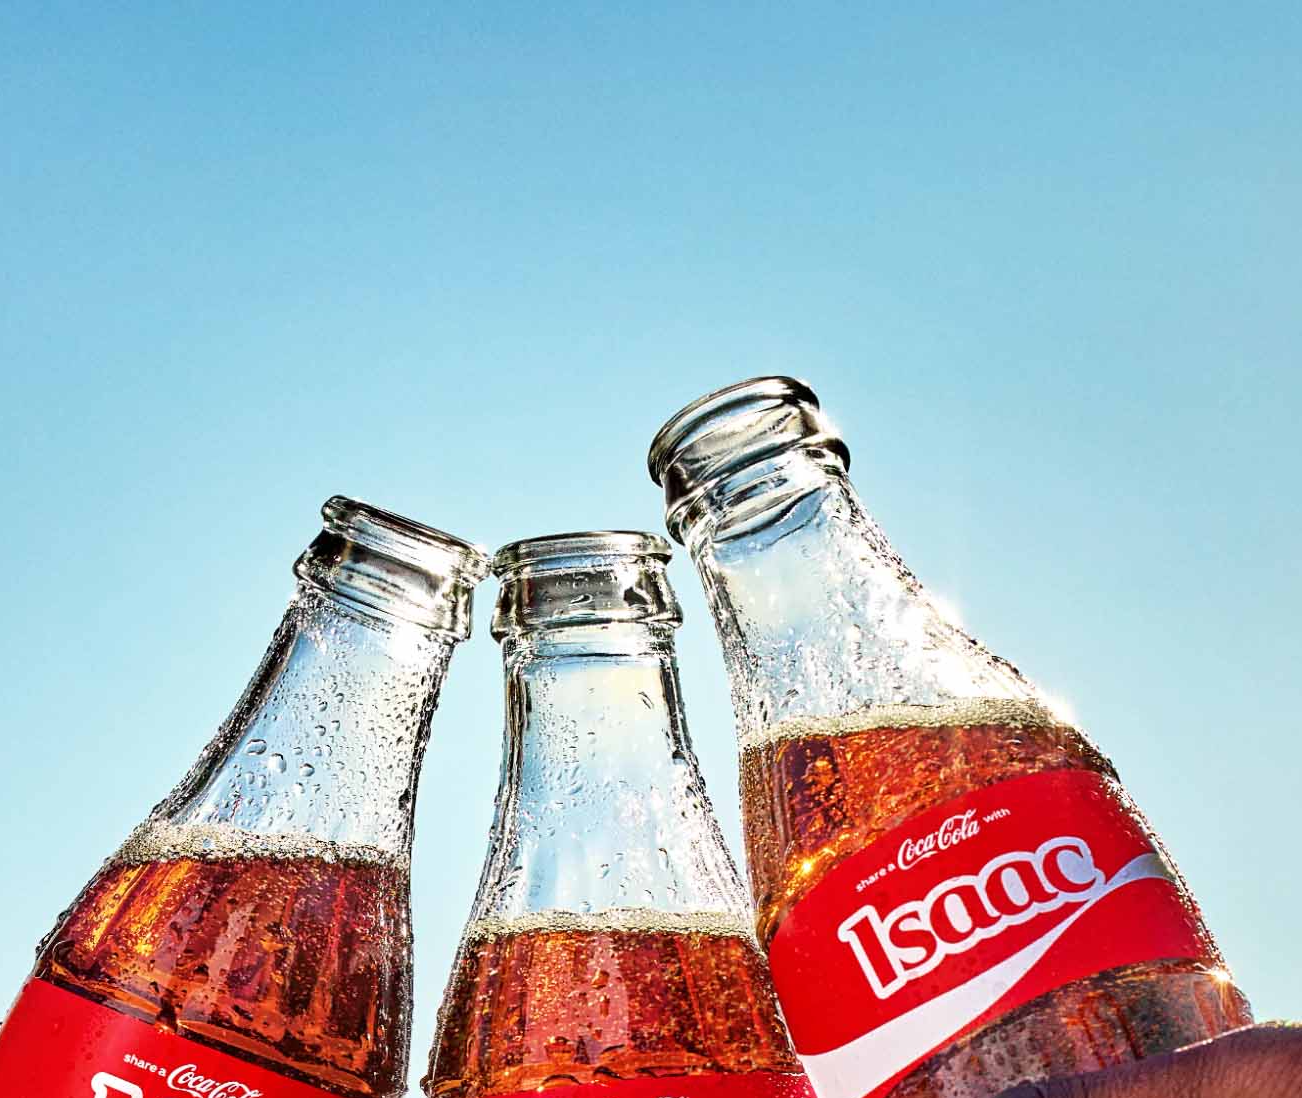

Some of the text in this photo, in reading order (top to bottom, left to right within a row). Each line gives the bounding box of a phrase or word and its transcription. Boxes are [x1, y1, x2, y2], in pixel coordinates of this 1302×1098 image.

[855, 808, 1011, 892] share a Coca-Cola with
[837, 836, 1107, 999] Isaac
[123, 1053, 158, 1072] share
[158, 1067, 167, 1077] a
